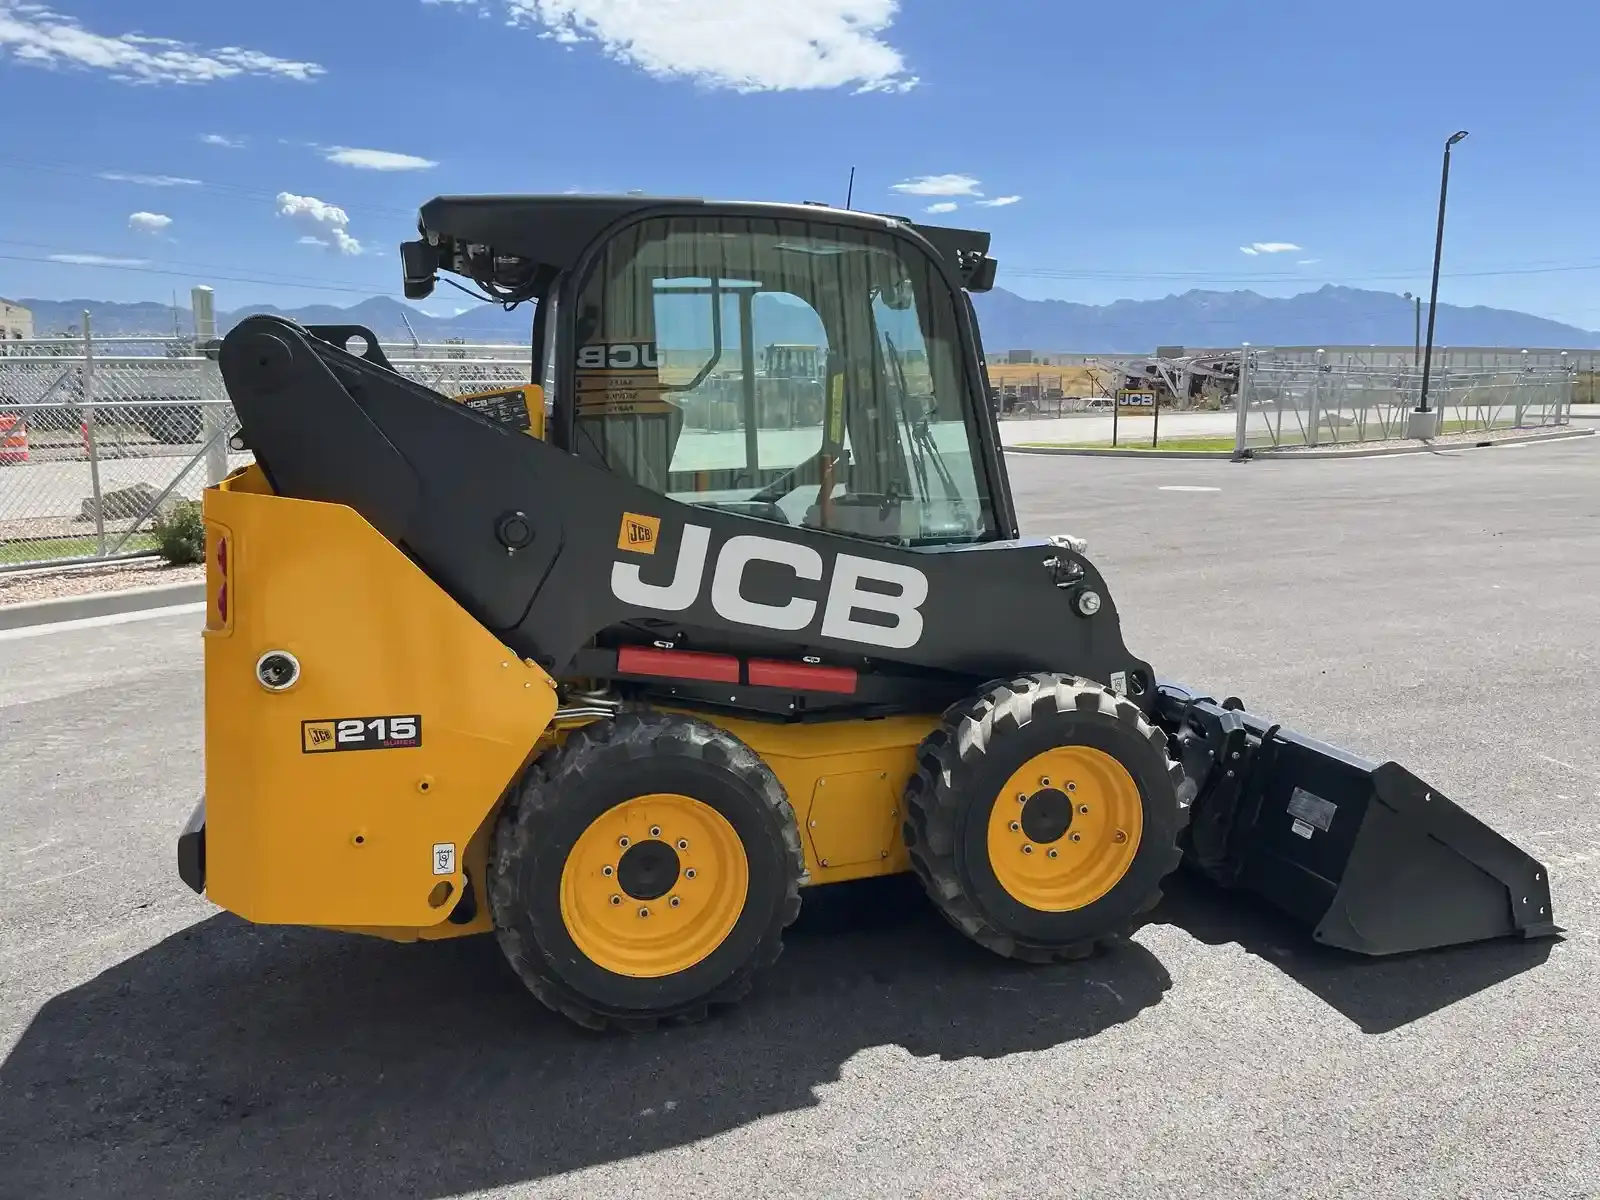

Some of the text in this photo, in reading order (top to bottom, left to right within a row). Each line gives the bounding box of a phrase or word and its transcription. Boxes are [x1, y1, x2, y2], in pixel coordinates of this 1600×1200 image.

[1119, 393, 1153, 406] JCB
[630, 523, 651, 542] JCB
[610, 523, 929, 649] JCB
[312, 729, 332, 743] JCB
[338, 717, 416, 742] 215
